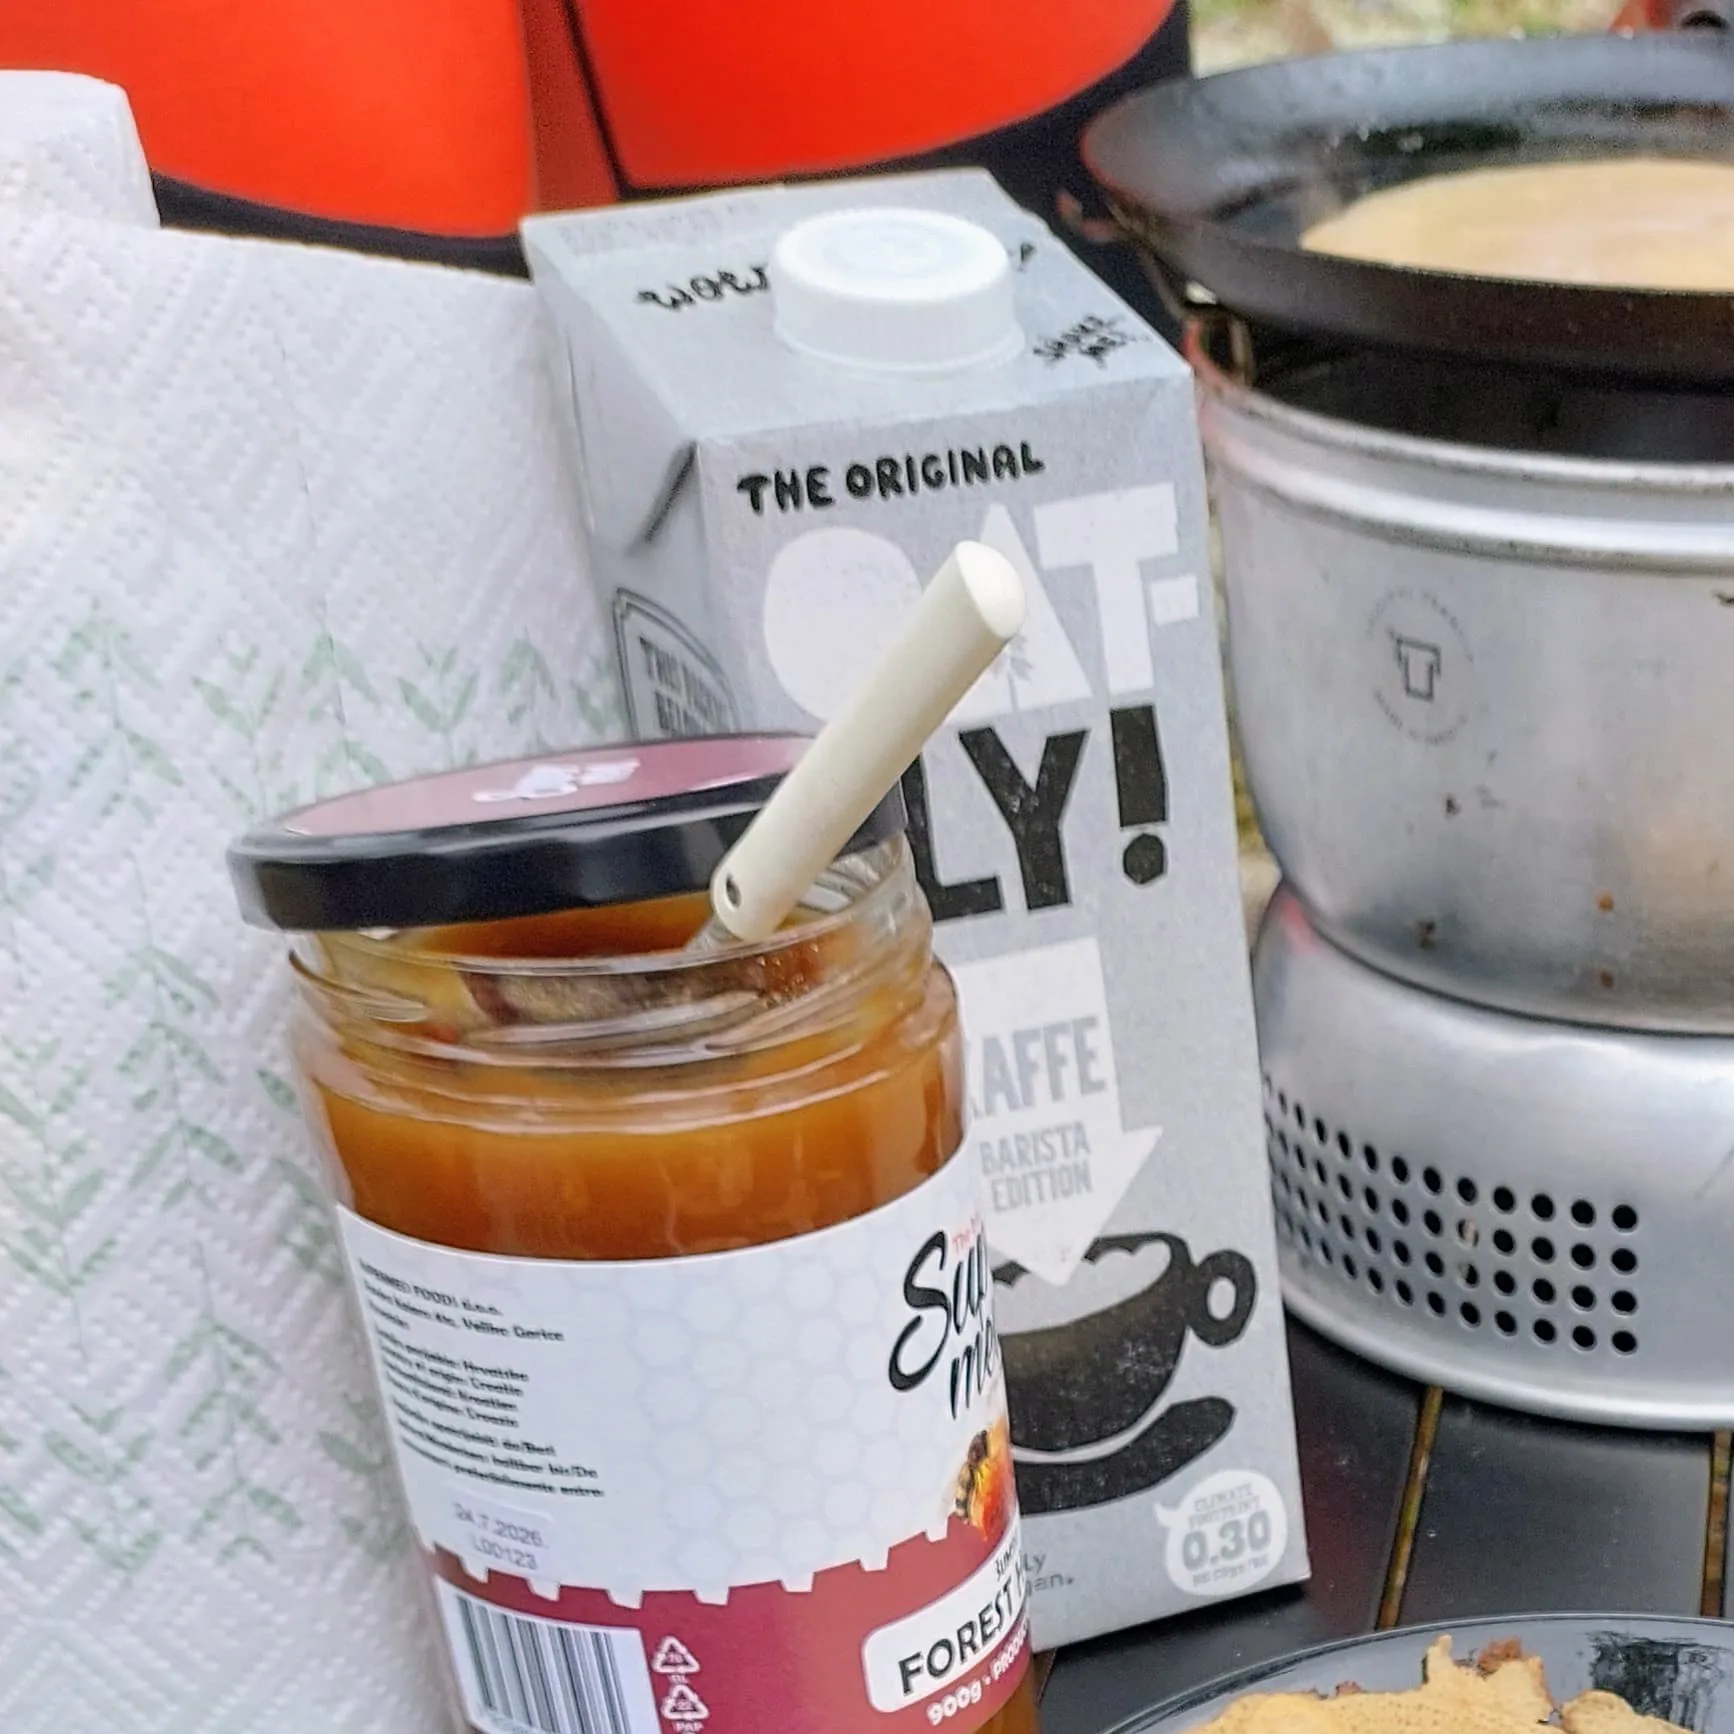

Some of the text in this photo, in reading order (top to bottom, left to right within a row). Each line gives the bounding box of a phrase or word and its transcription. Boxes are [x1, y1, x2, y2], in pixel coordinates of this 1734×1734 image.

[737, 440, 1045, 514] THE ORIGINAL
[972, 1015, 1107, 1119] AFFE
[979, 1120, 1092, 1176] BARISTA
[991, 1160, 1094, 1215] EDITION
[1181, 1509, 1272, 1572] 0.30
[899, 1577, 1013, 1697] FOREST
[926, 1679, 982, 1726] 900g
